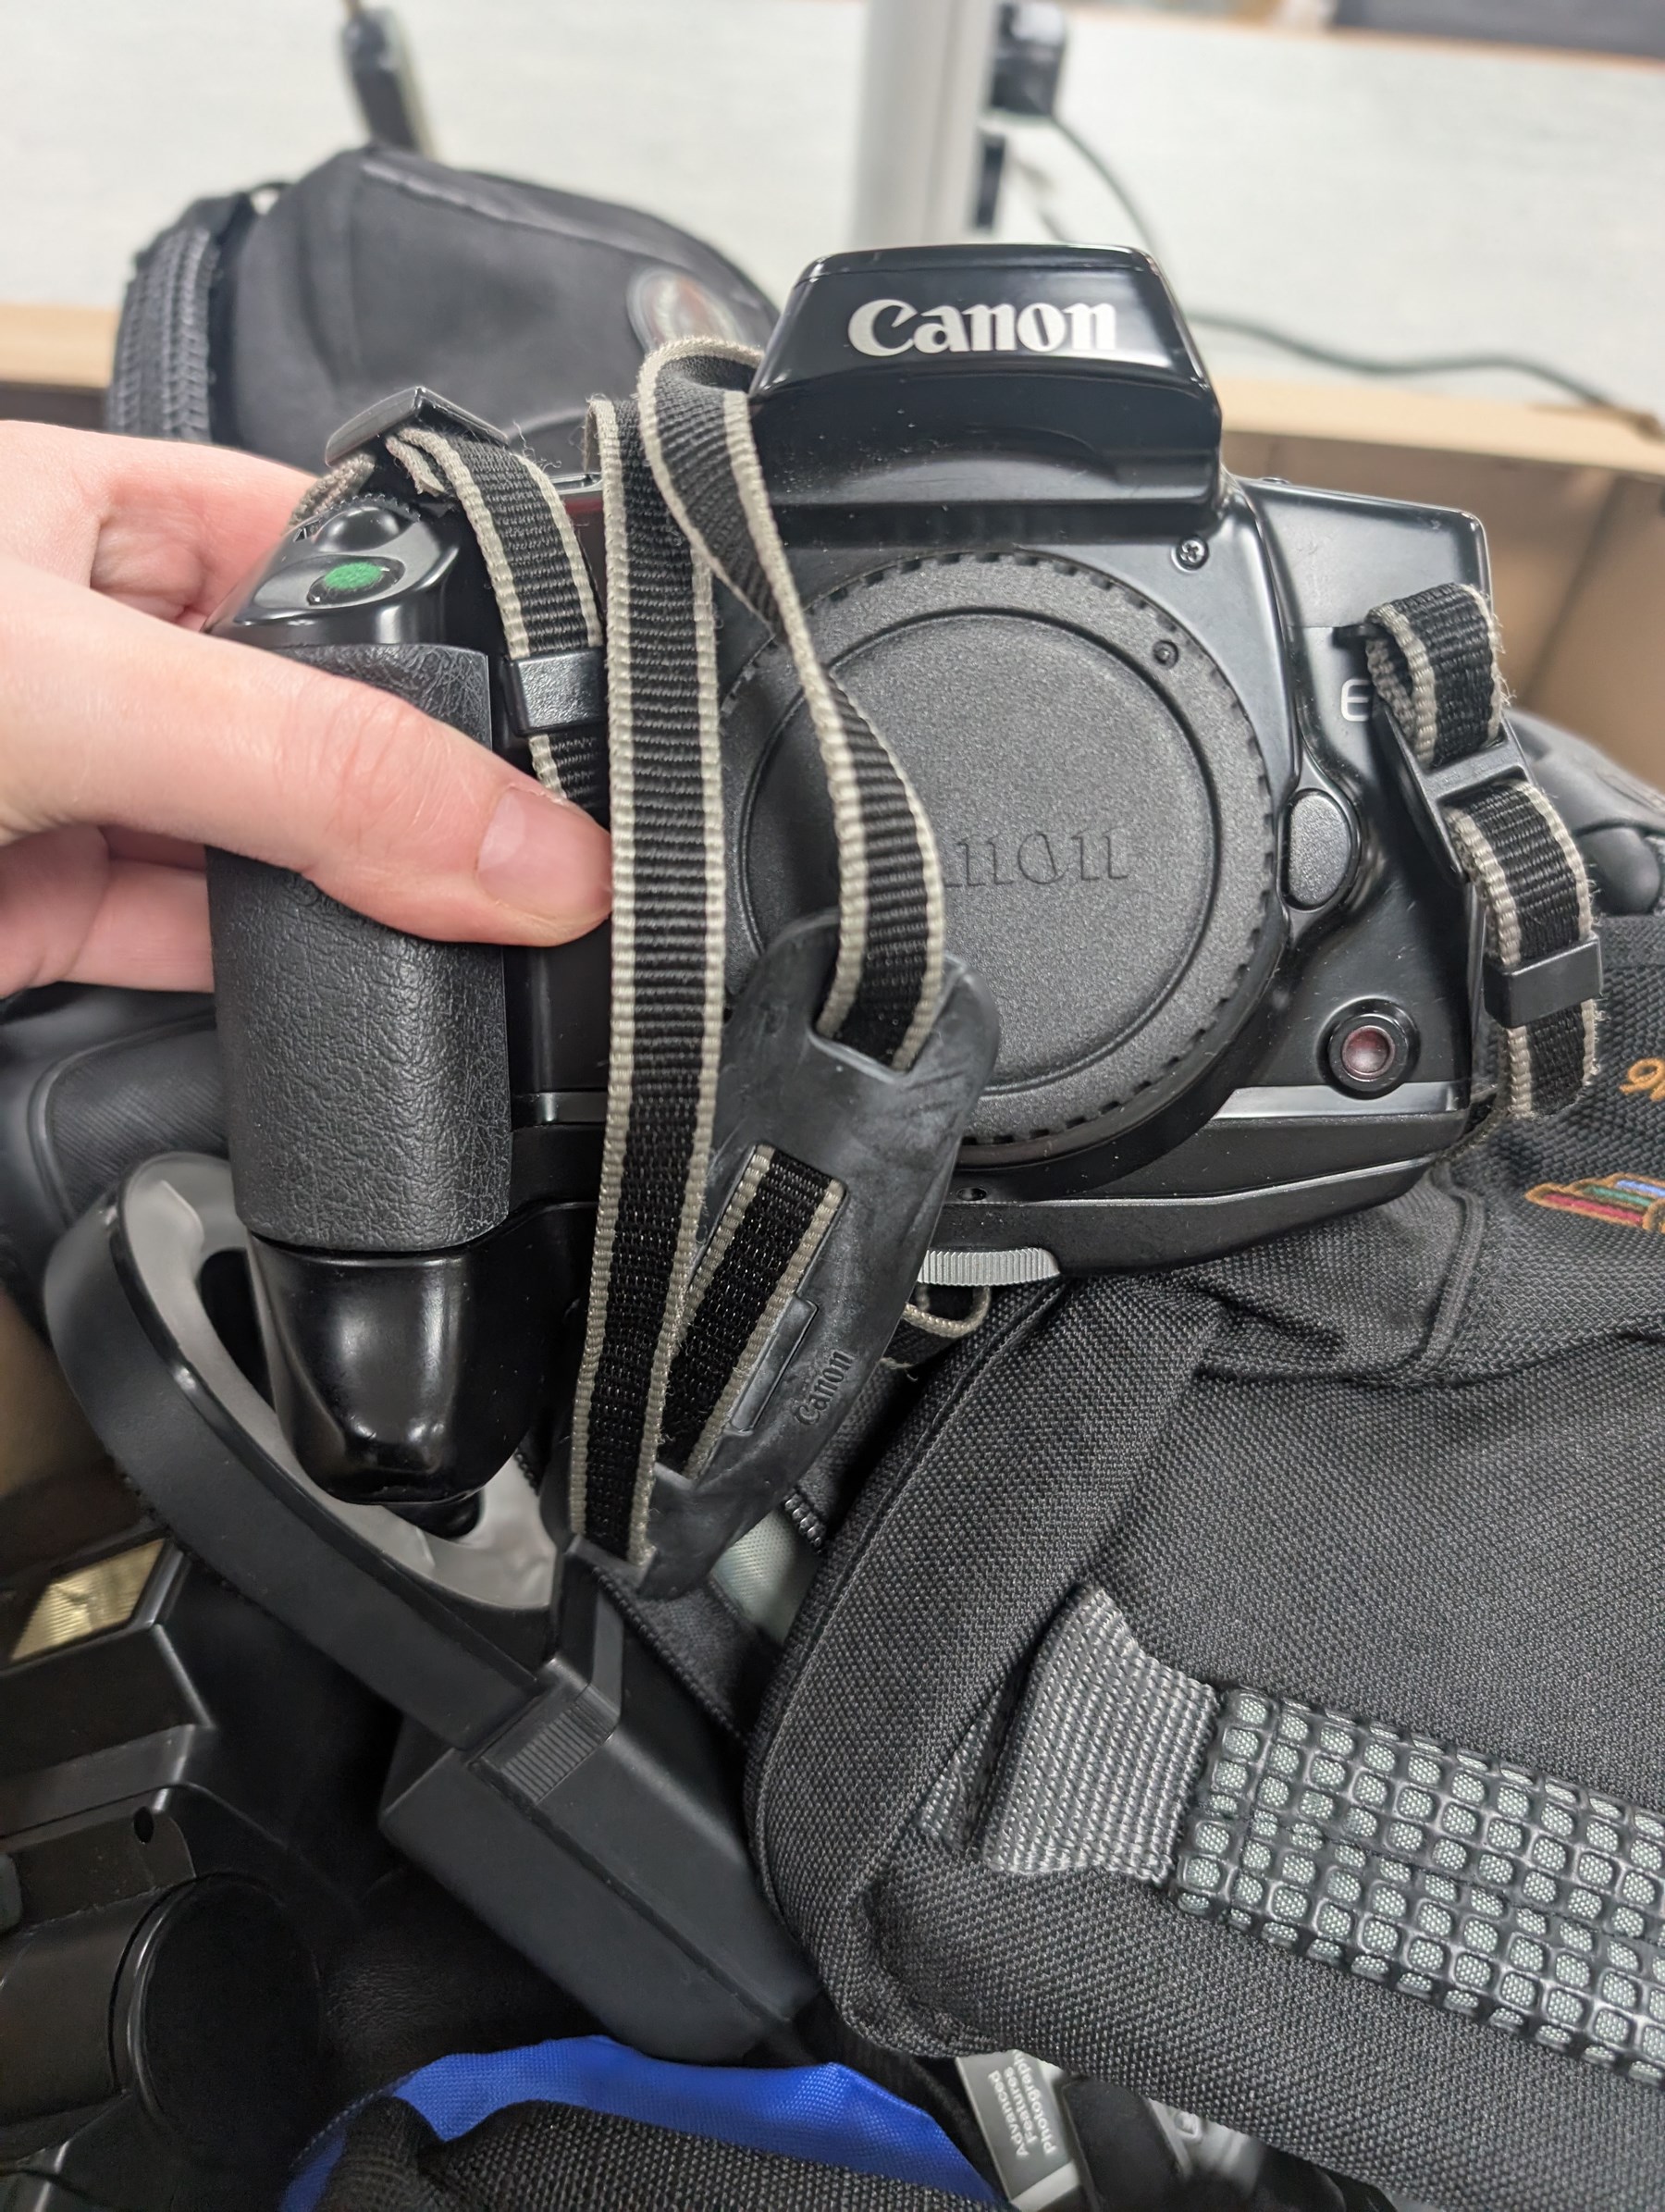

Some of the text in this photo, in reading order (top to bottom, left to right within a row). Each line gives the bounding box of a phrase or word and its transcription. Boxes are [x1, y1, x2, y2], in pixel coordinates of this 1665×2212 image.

[847, 298, 1116, 357] Canon
[942, 830, 1130, 888] non
[795, 1349, 856, 1425] Canon
[987, 2070, 1030, 2156] Advanced
[1003, 2066, 1038, 2144] Features
